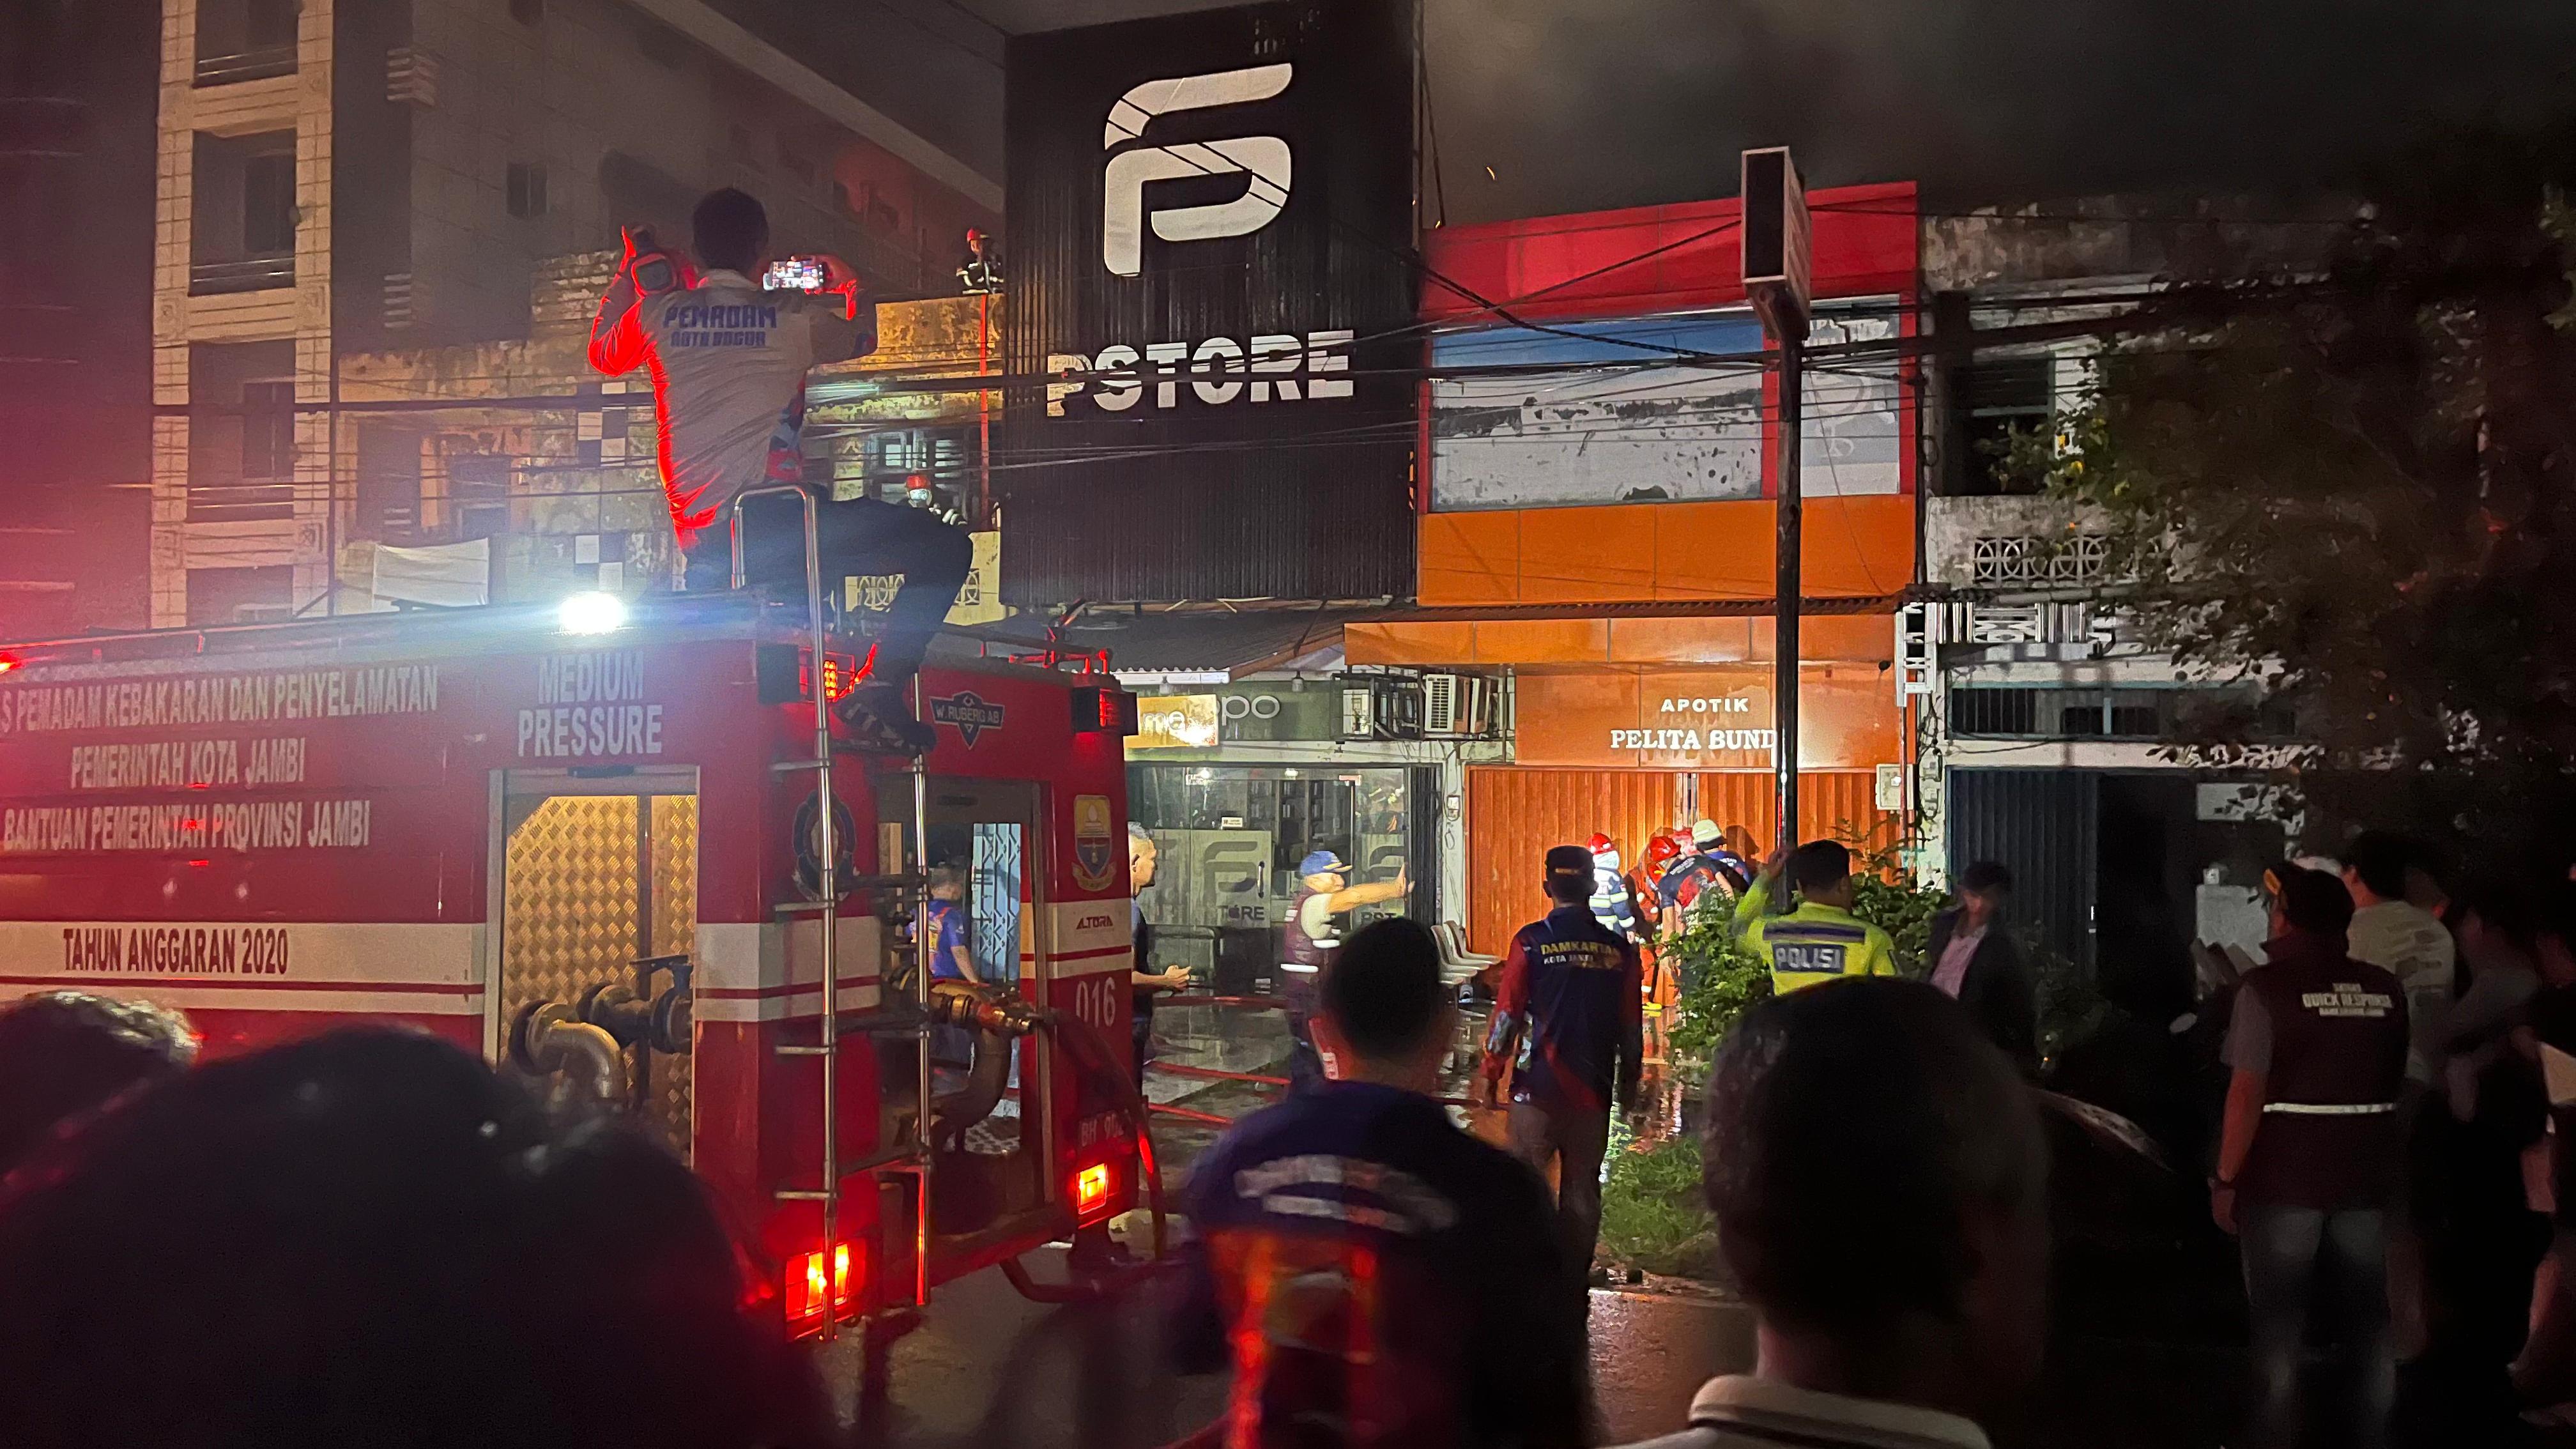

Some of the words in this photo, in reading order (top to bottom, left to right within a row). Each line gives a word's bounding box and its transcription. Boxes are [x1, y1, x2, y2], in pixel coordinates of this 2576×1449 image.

[663, 305, 777, 328] PEMADAM
[1047, 329, 1354, 417] PSTORE
[0, 691, 12, 733] S
[17, 686, 102, 732] PEMADAM
[105, 678, 224, 726] KEBAKARAN
[229, 675, 268, 721] DAN
[273, 665, 438, 719] PENYELAMATAN
[539, 651, 644, 703] MEDIUM
[1143, 710, 1186, 733] me
[1661, 698, 1749, 712] APOTIK
[518, 704, 663, 757] PRESSURE
[1610, 729, 1701, 750] PELITA
[1708, 729, 1777, 750] BUND
[71, 741, 185, 789] PEMERINTAH
[190, 739, 238, 786] KOTA
[245, 737, 305, 786] JAMBI
[4, 807, 88, 852] BANTUAN
[91, 803, 208, 851] PEMERINTAH
[211, 801, 303, 852] PROVINSI
[307, 799, 370, 848] JAMBI
[1076, 915, 1114, 930] ALTORA
[64, 928, 122, 971] TAHUN
[127, 928, 235, 974] ANGGARAN
[241, 928, 288, 975] 2020
[1544, 954, 1567, 965] KOTA
[1775, 947, 1841, 969] POLISI
[1076, 977, 1116, 1028] 016
